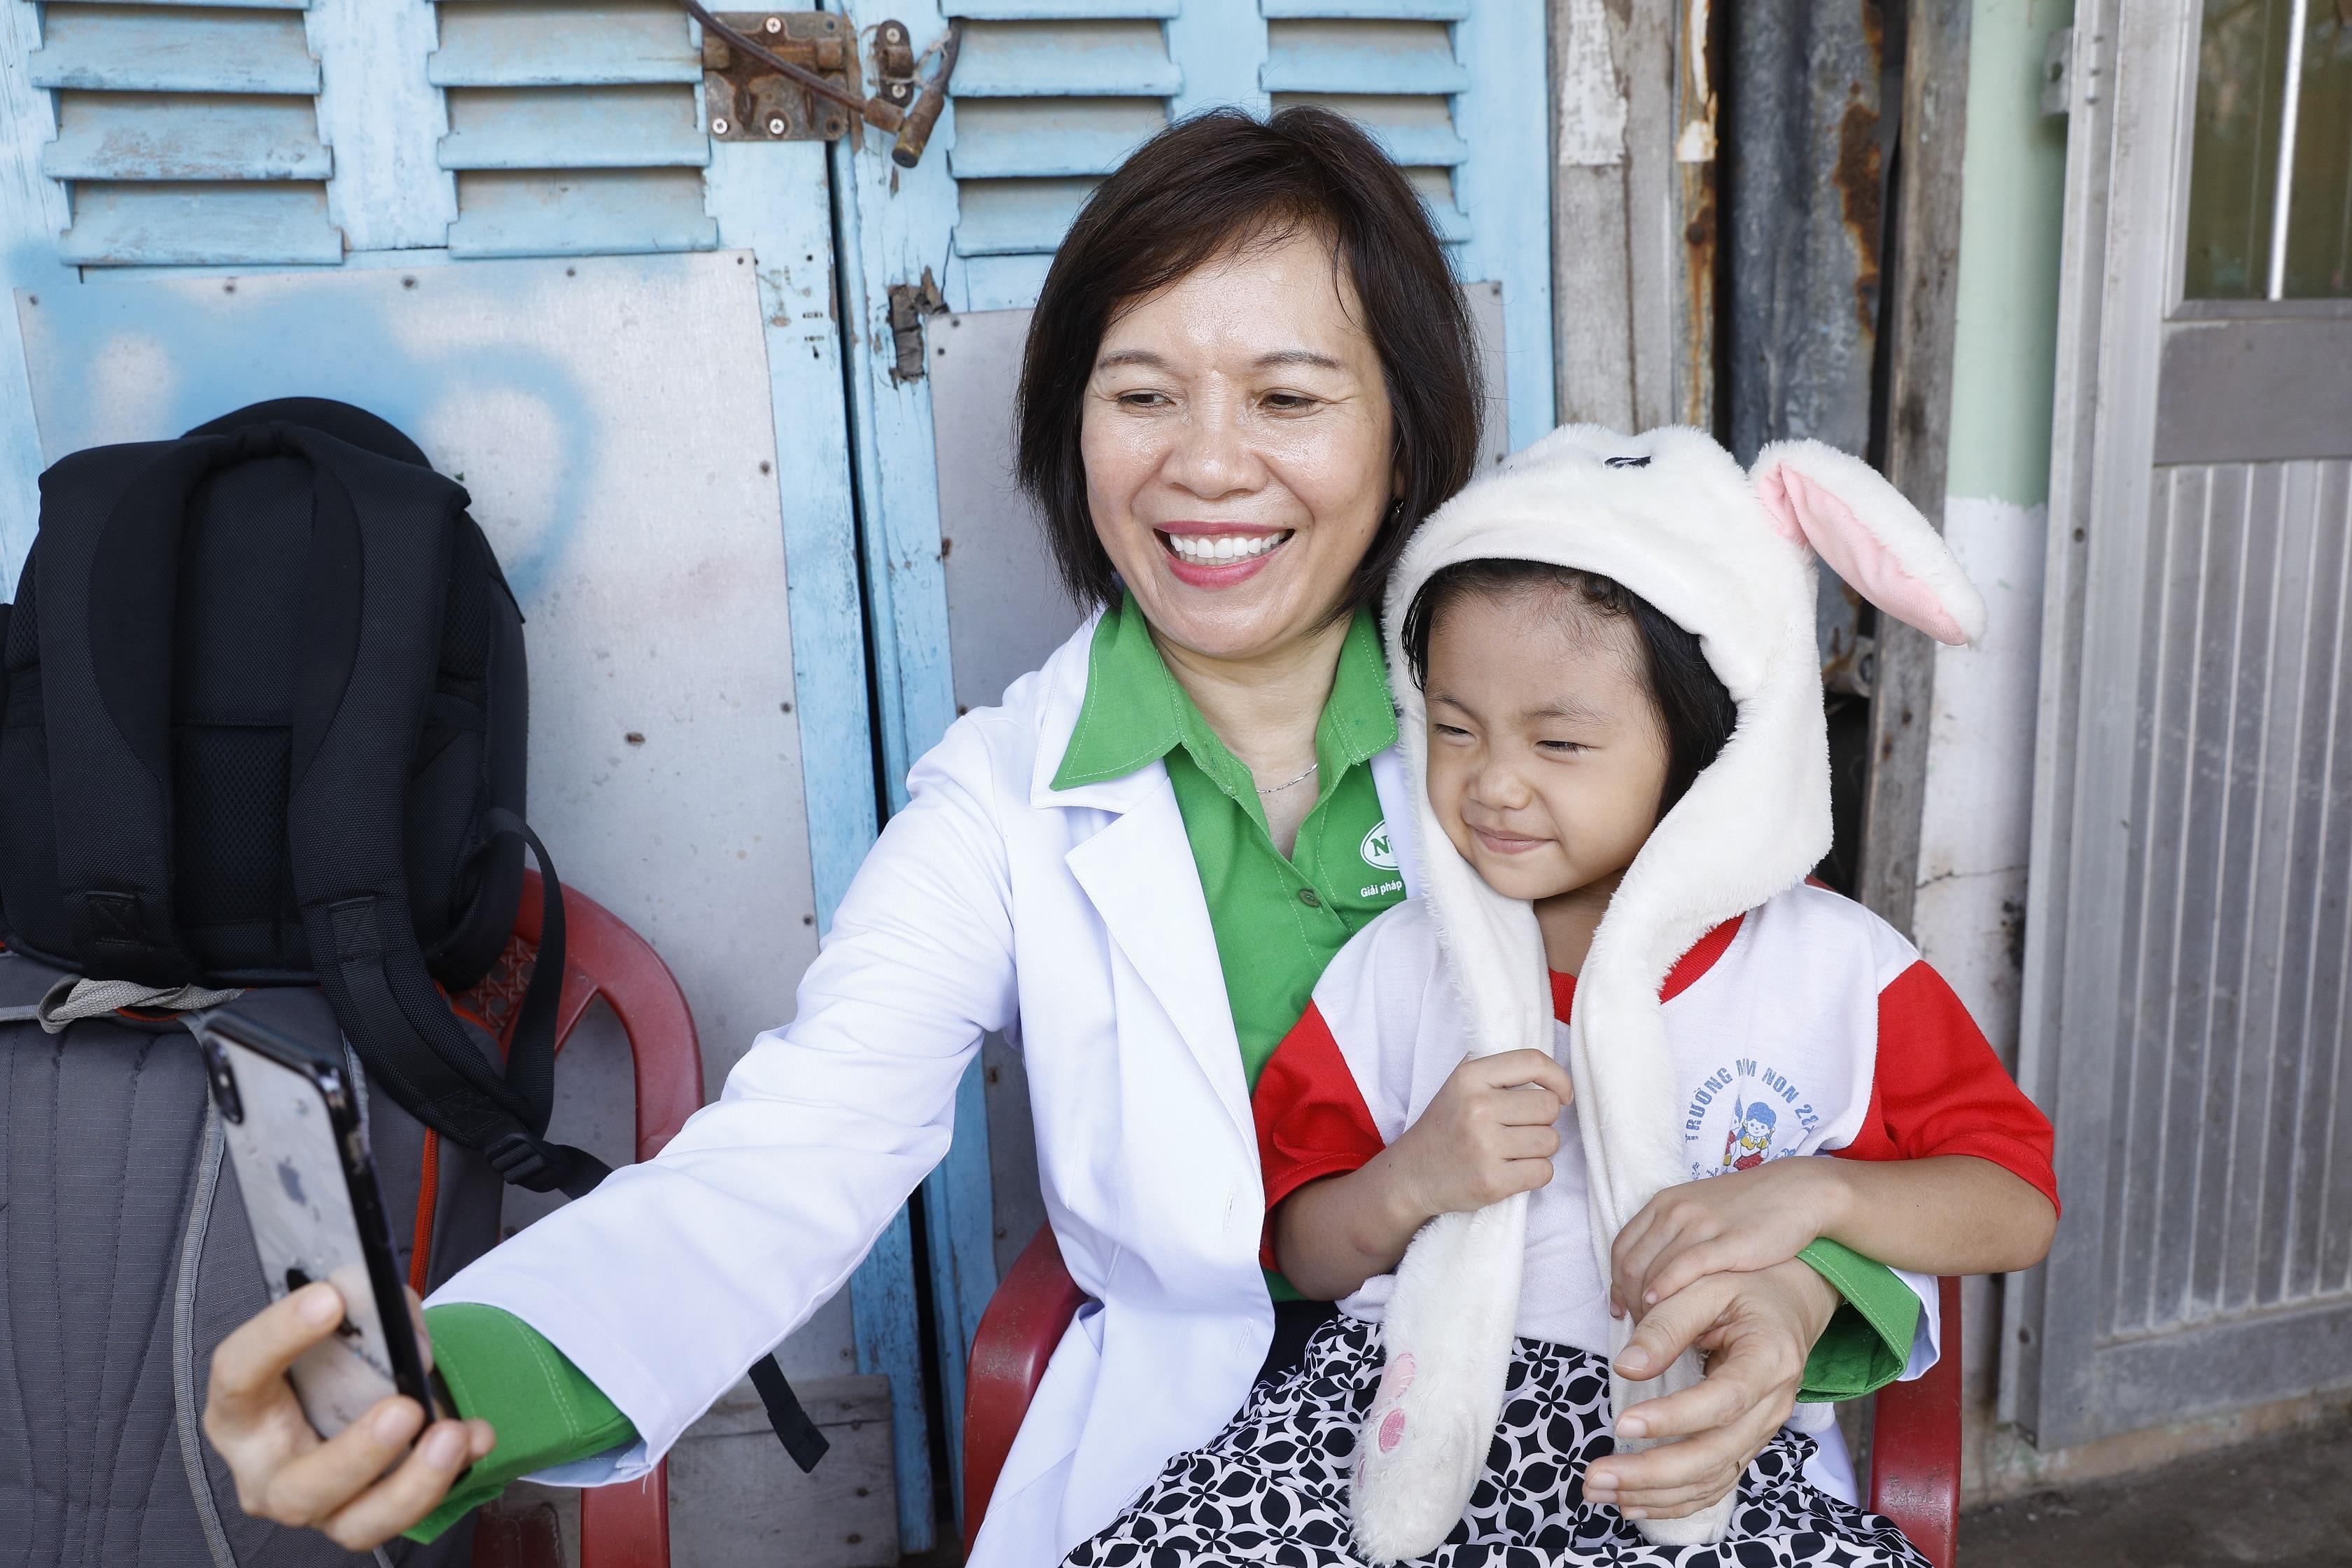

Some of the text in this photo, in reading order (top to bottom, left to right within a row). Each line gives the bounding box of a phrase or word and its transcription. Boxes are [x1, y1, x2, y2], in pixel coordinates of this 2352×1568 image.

[1361, 881, 1402, 897] Giải pháp
[1762, 1068, 1800, 1103] NON
